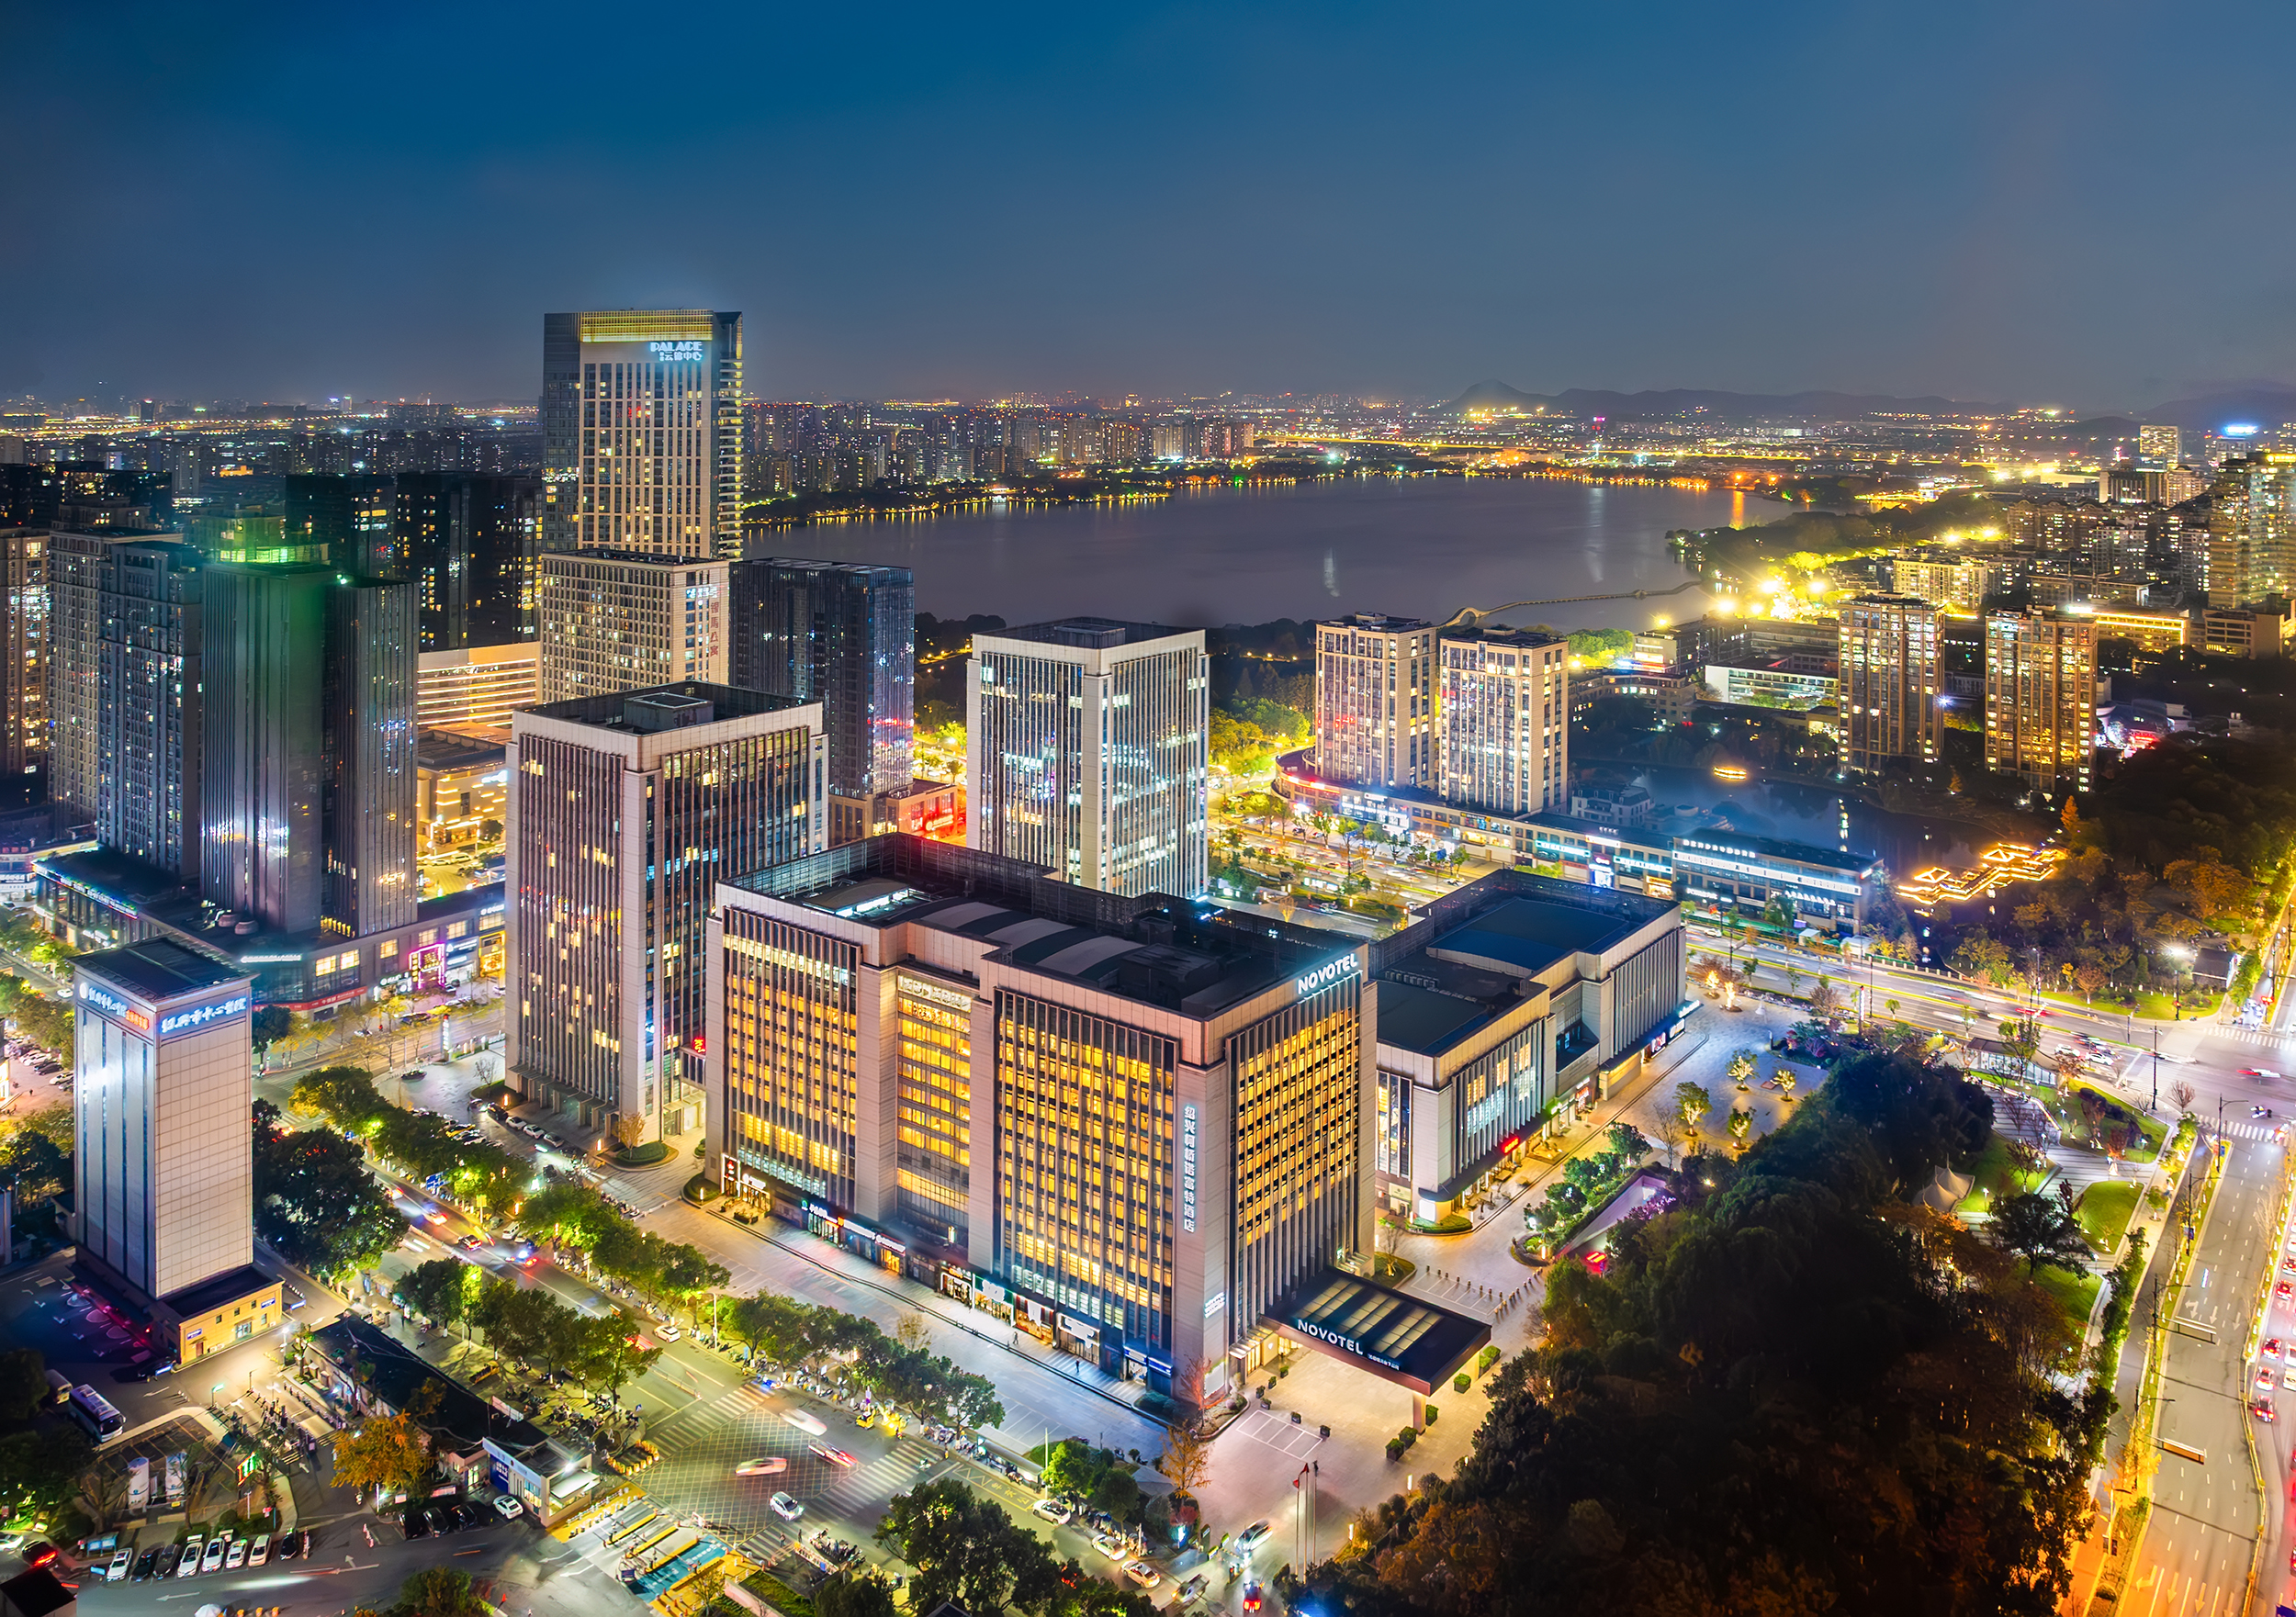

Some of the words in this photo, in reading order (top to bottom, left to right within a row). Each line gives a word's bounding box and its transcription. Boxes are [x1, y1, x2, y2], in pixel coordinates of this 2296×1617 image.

[650, 341, 703, 352] PALACE
[1297, 952, 1359, 994] NOVOTEL
[1297, 1319, 1364, 1356] NOVOTEL
